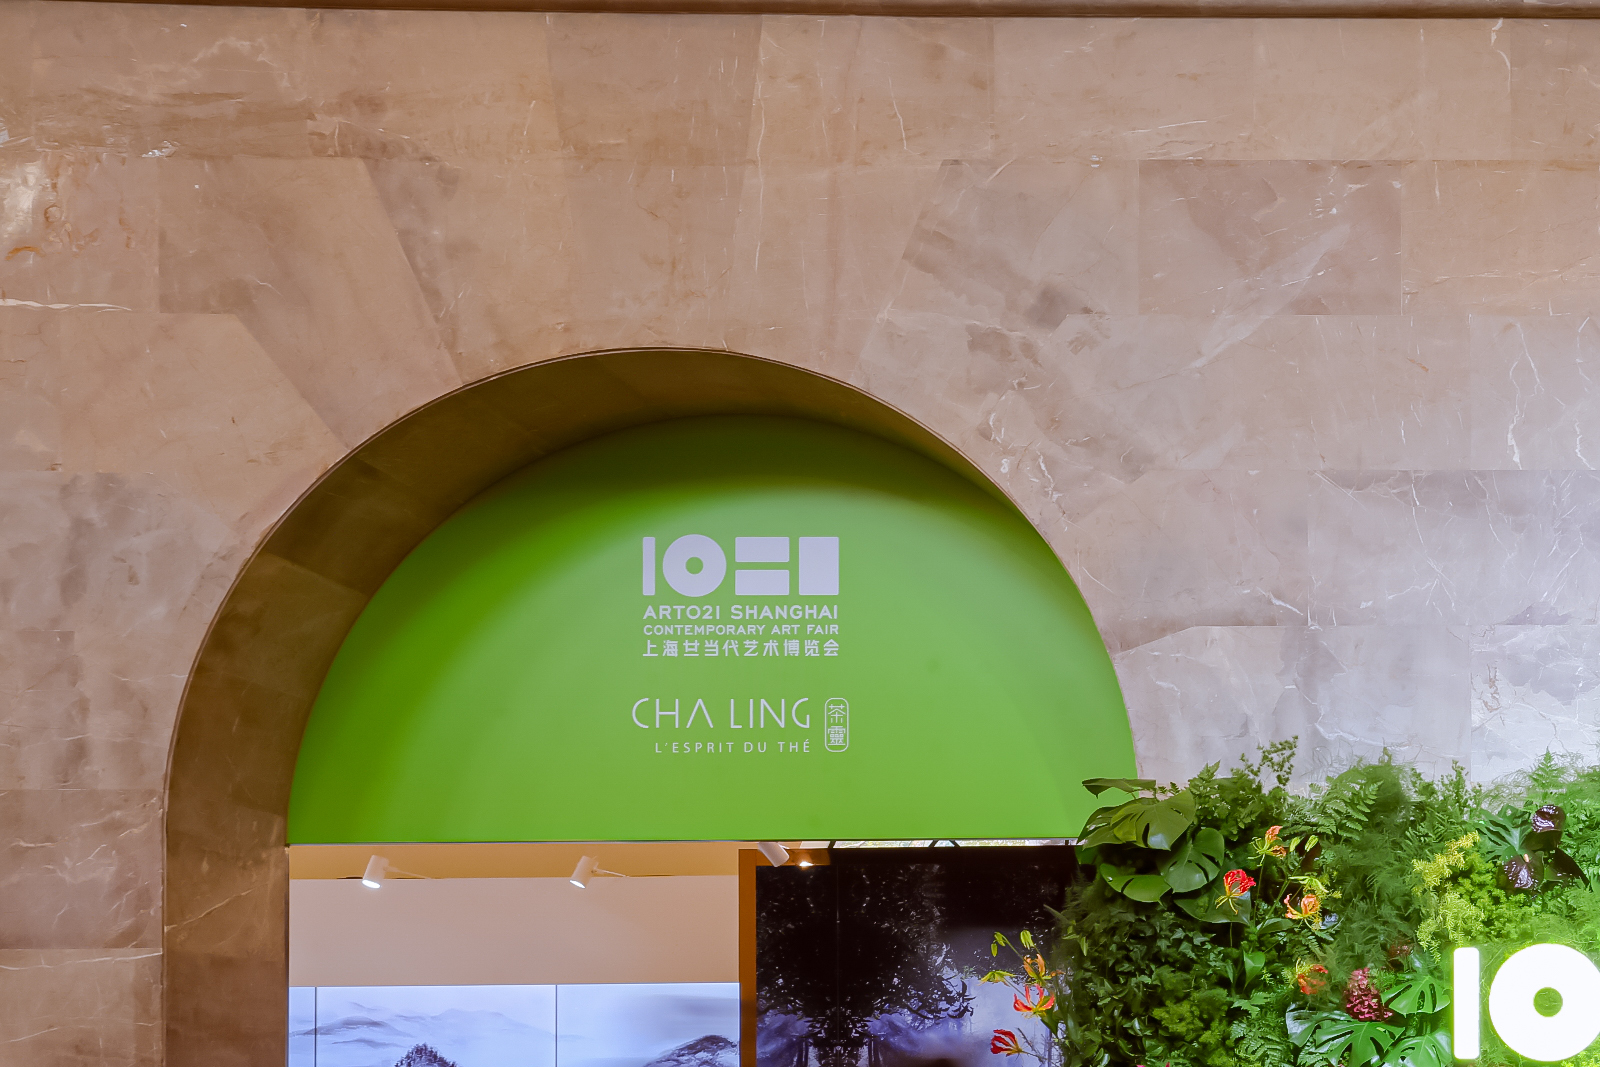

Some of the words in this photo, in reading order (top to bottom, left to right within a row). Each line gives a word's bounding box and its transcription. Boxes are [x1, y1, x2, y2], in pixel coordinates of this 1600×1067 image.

[731, 605, 837, 619] SHANGHAI
[644, 625, 765, 635] CONTEMPORARY
[771, 625, 800, 634] ART
[807, 625, 838, 634] FAIR
[632, 698, 713, 728] CHA
[731, 698, 809, 728] LING
[744, 742, 766, 752] DU
[778, 739, 809, 752] THÉ
